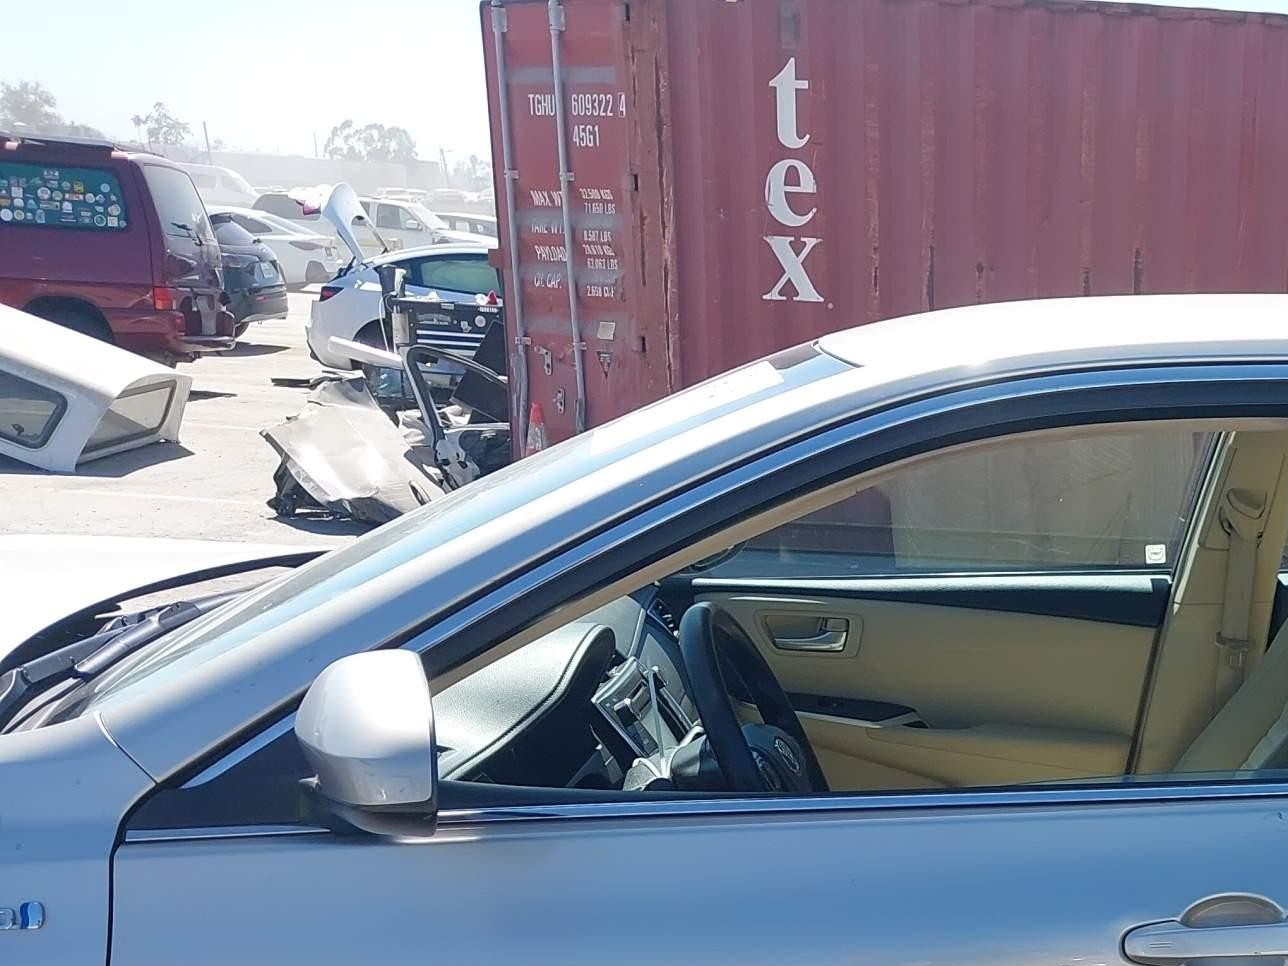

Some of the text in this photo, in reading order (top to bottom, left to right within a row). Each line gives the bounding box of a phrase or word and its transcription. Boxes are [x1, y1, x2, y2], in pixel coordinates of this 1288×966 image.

[528, 93, 556, 116] TGHU
[571, 94, 613, 116] 609322
[573, 125, 600, 147] 45G1
[762, 57, 825, 302] tex
[534, 245, 568, 262] PAYLOAD
